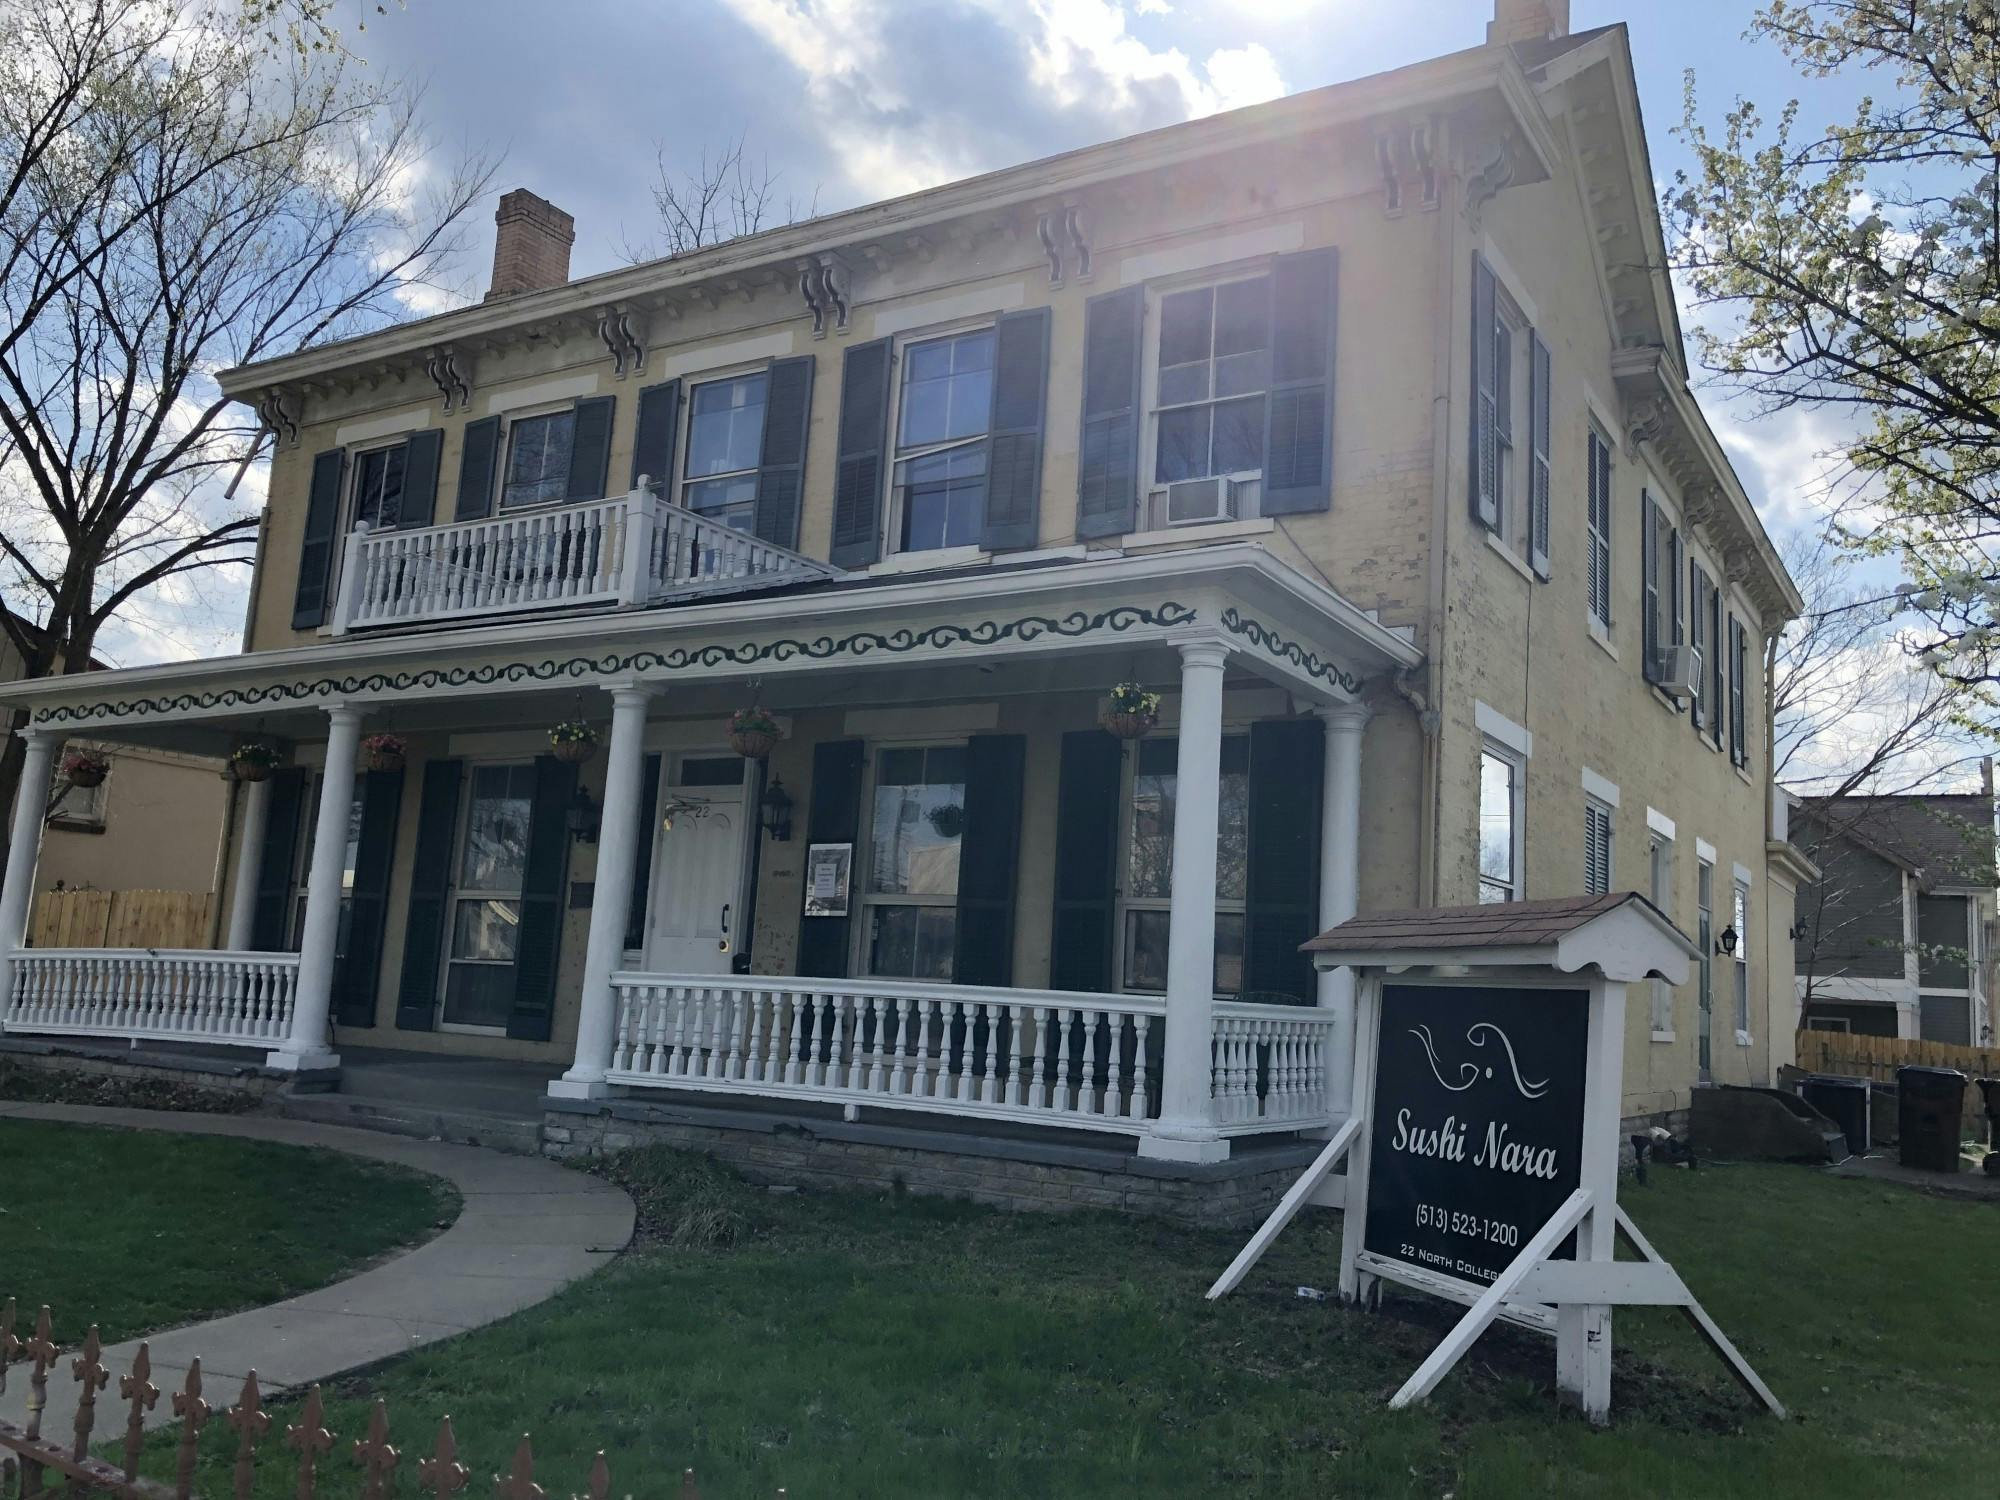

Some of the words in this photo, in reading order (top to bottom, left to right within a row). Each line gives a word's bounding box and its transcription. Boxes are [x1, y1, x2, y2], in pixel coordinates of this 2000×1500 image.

[695, 806, 710, 818] 22
[1392, 1108, 1466, 1162] Sushi
[1474, 1121, 1558, 1180] Nara
[1416, 1203, 1448, 1234] (513)
[1451, 1211, 1518, 1247] 523-1200
[1400, 1243, 1415, 1256] 22
[1418, 1249, 1453, 1269] NORTH
[1456, 1259, 1502, 1281] COLLEG
